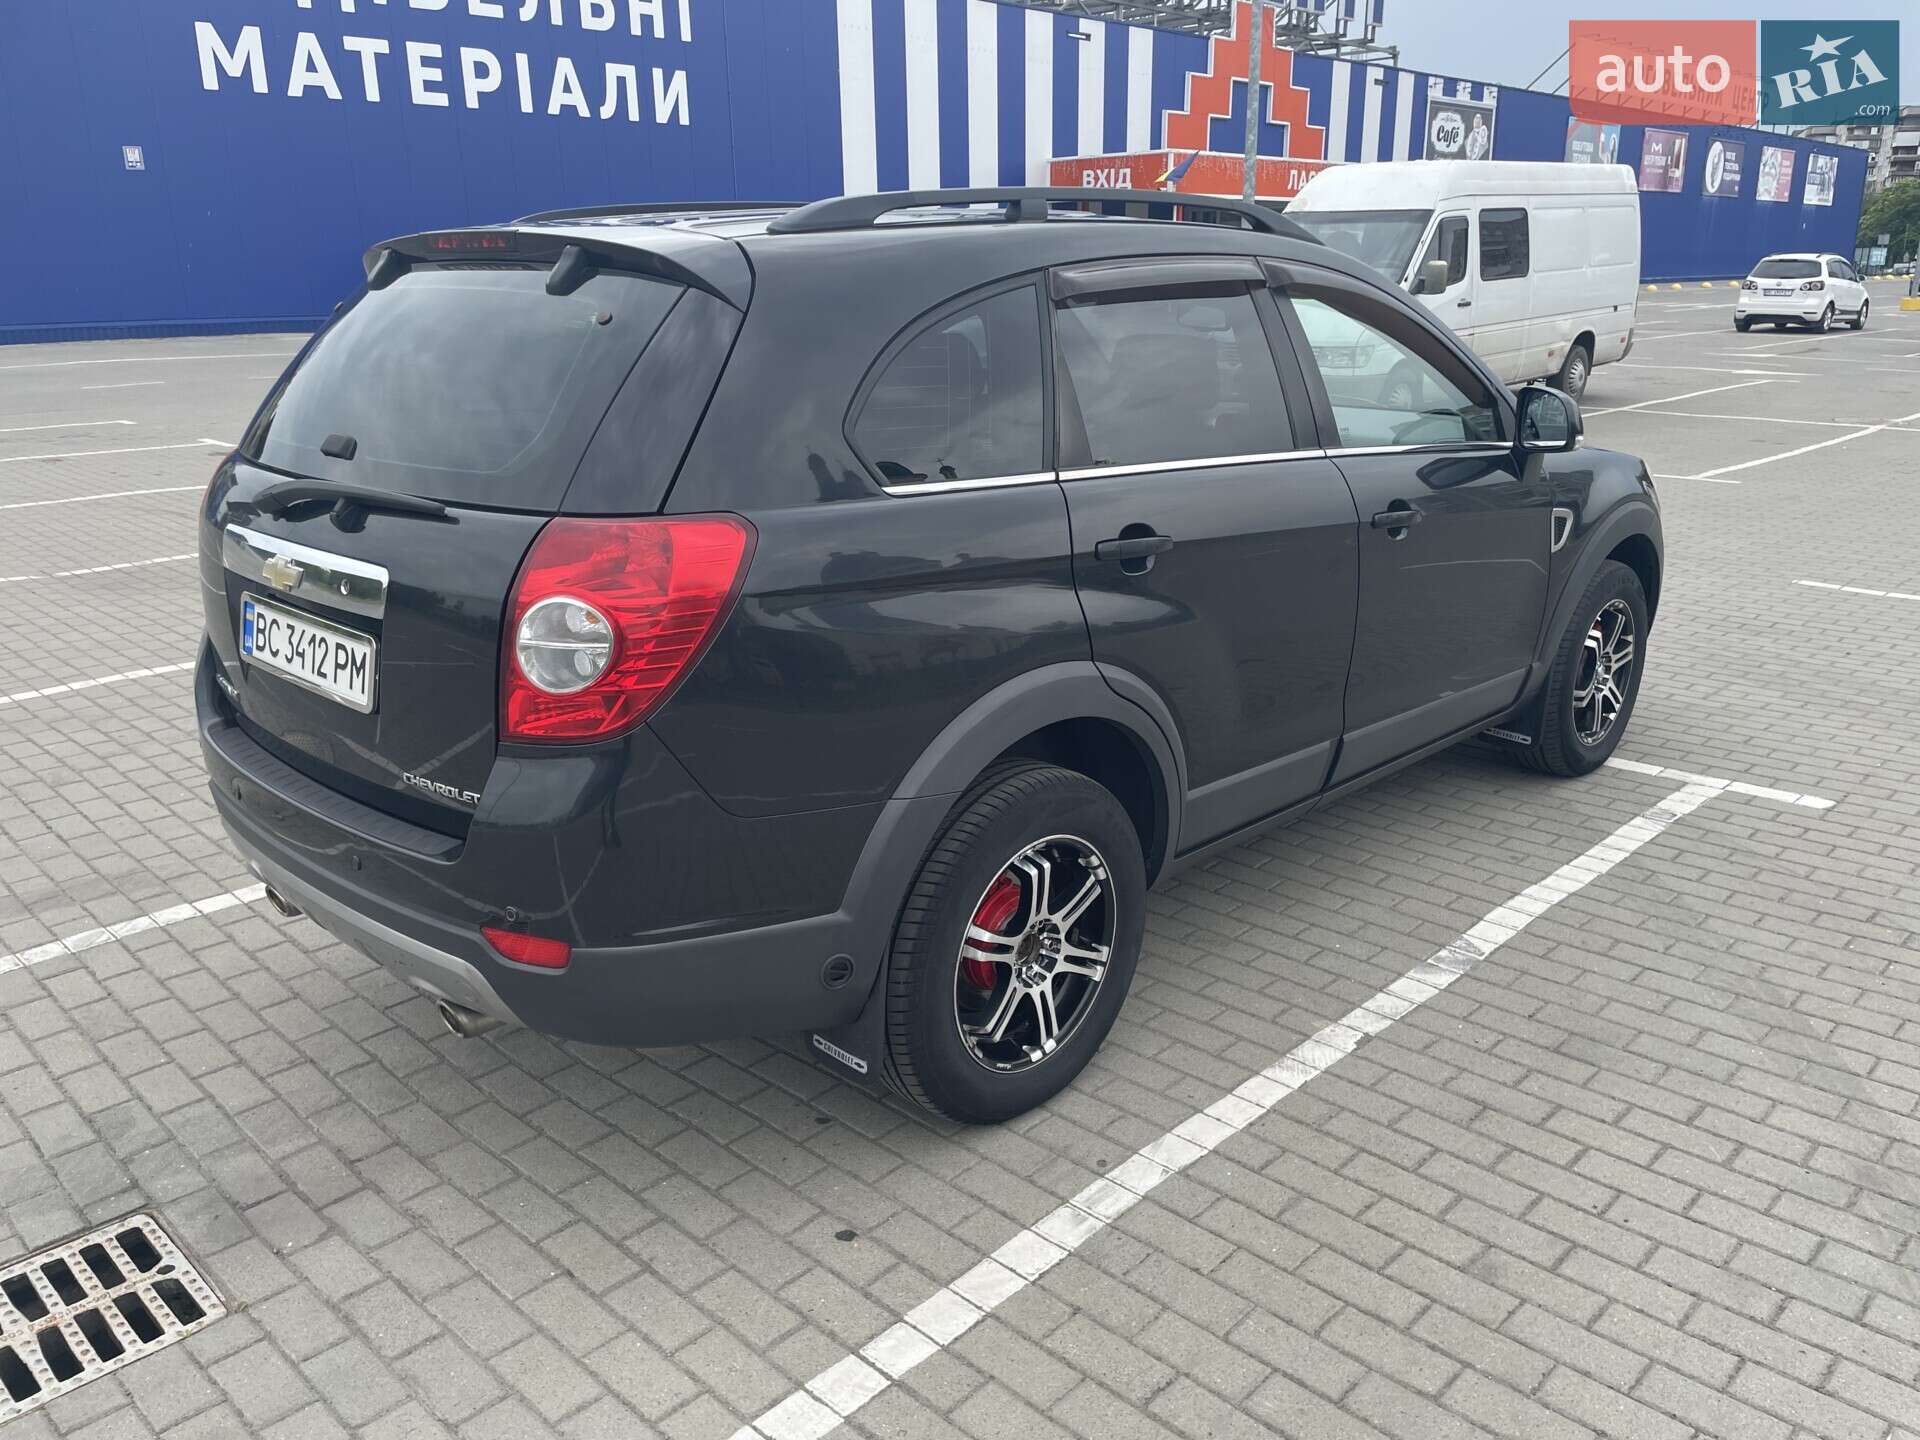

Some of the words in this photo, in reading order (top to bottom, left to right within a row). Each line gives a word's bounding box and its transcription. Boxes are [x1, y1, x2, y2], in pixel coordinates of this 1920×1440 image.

[194, 21, 691, 126] МАТЕРІАЛИ
[1436, 124, 1460, 148] Café
[1082, 167, 1132, 190] ВХІД
[402, 771, 481, 805] CHEVROLET
